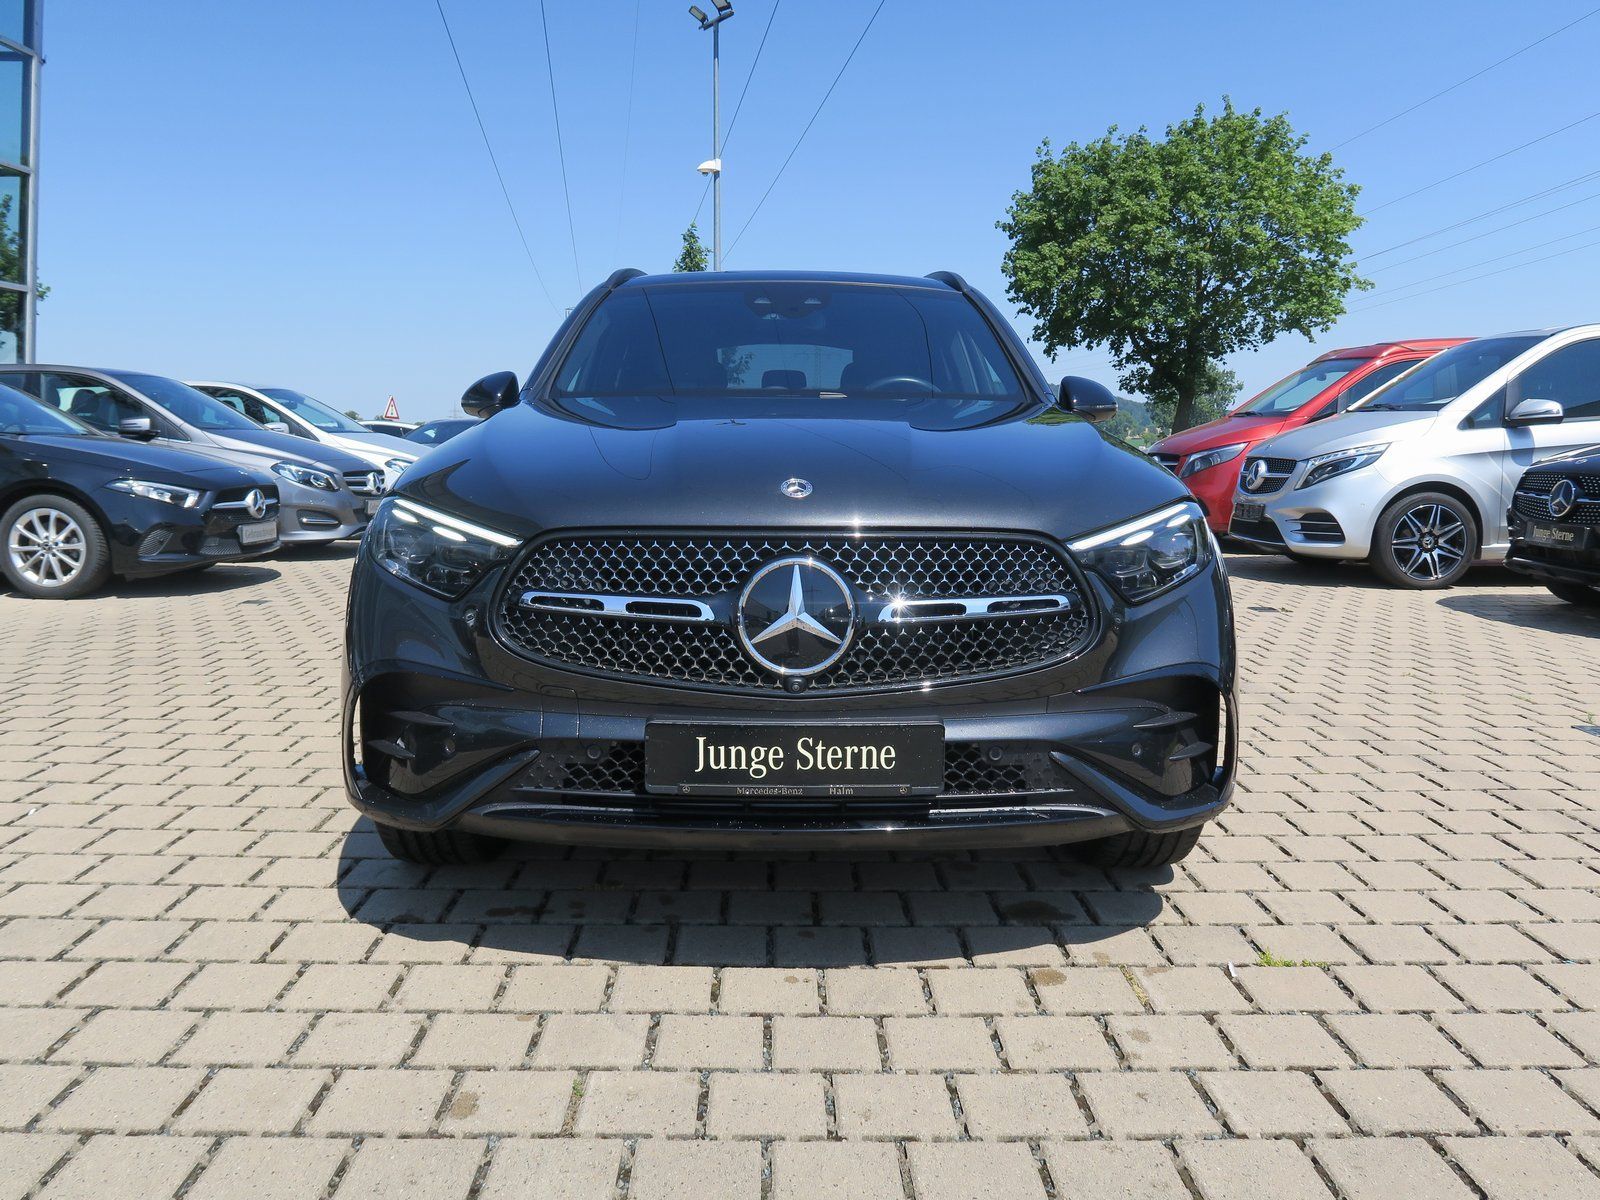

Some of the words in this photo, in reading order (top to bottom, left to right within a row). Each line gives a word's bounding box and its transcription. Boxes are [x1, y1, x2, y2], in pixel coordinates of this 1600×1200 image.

[695, 736, 784, 779] Junge
[796, 737, 896, 770] Sterne
[736, 787, 803, 795] Mercedes-Benz
